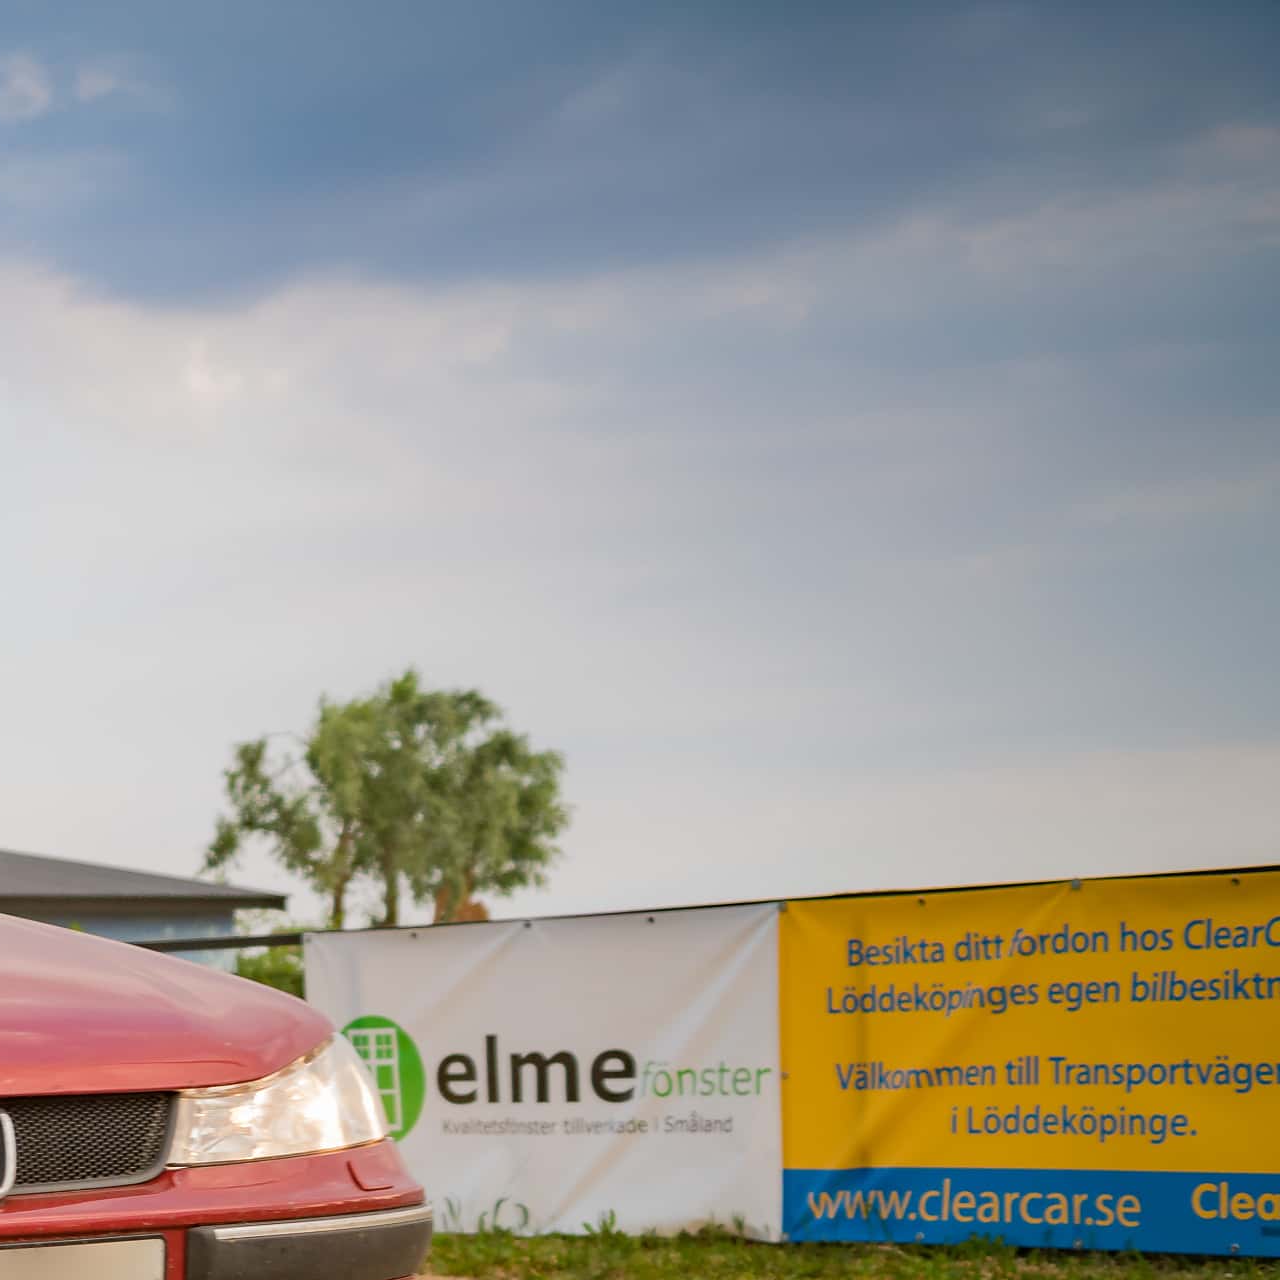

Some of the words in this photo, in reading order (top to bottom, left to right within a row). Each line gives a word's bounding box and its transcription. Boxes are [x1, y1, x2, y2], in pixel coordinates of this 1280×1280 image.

[847, 935, 945, 966] Besikta
[953, 931, 1004, 962] ditt
[1007, 924, 1110, 957] fordon
[1118, 921, 1174, 952] hos
[1183, 915, 1280, 950] ClearC
[826, 981, 1039, 1017] Löddeköpinges
[1048, 980, 1121, 1012] egen
[437, 1035, 637, 1104] elme
[641, 1060, 772, 1098] fönster
[835, 1061, 996, 1091] Välkommen
[1005, 1055, 1040, 1086] till
[1048, 1055, 1280, 1093] Transportväge
[663, 1110, 734, 1134] Småland
[950, 1105, 958, 1134] i
[966, 1104, 1198, 1144] Löddeköpinge.
[807, 1177, 1141, 1228] www.clearcar.se
[1190, 1181, 1280, 1221] Clea
